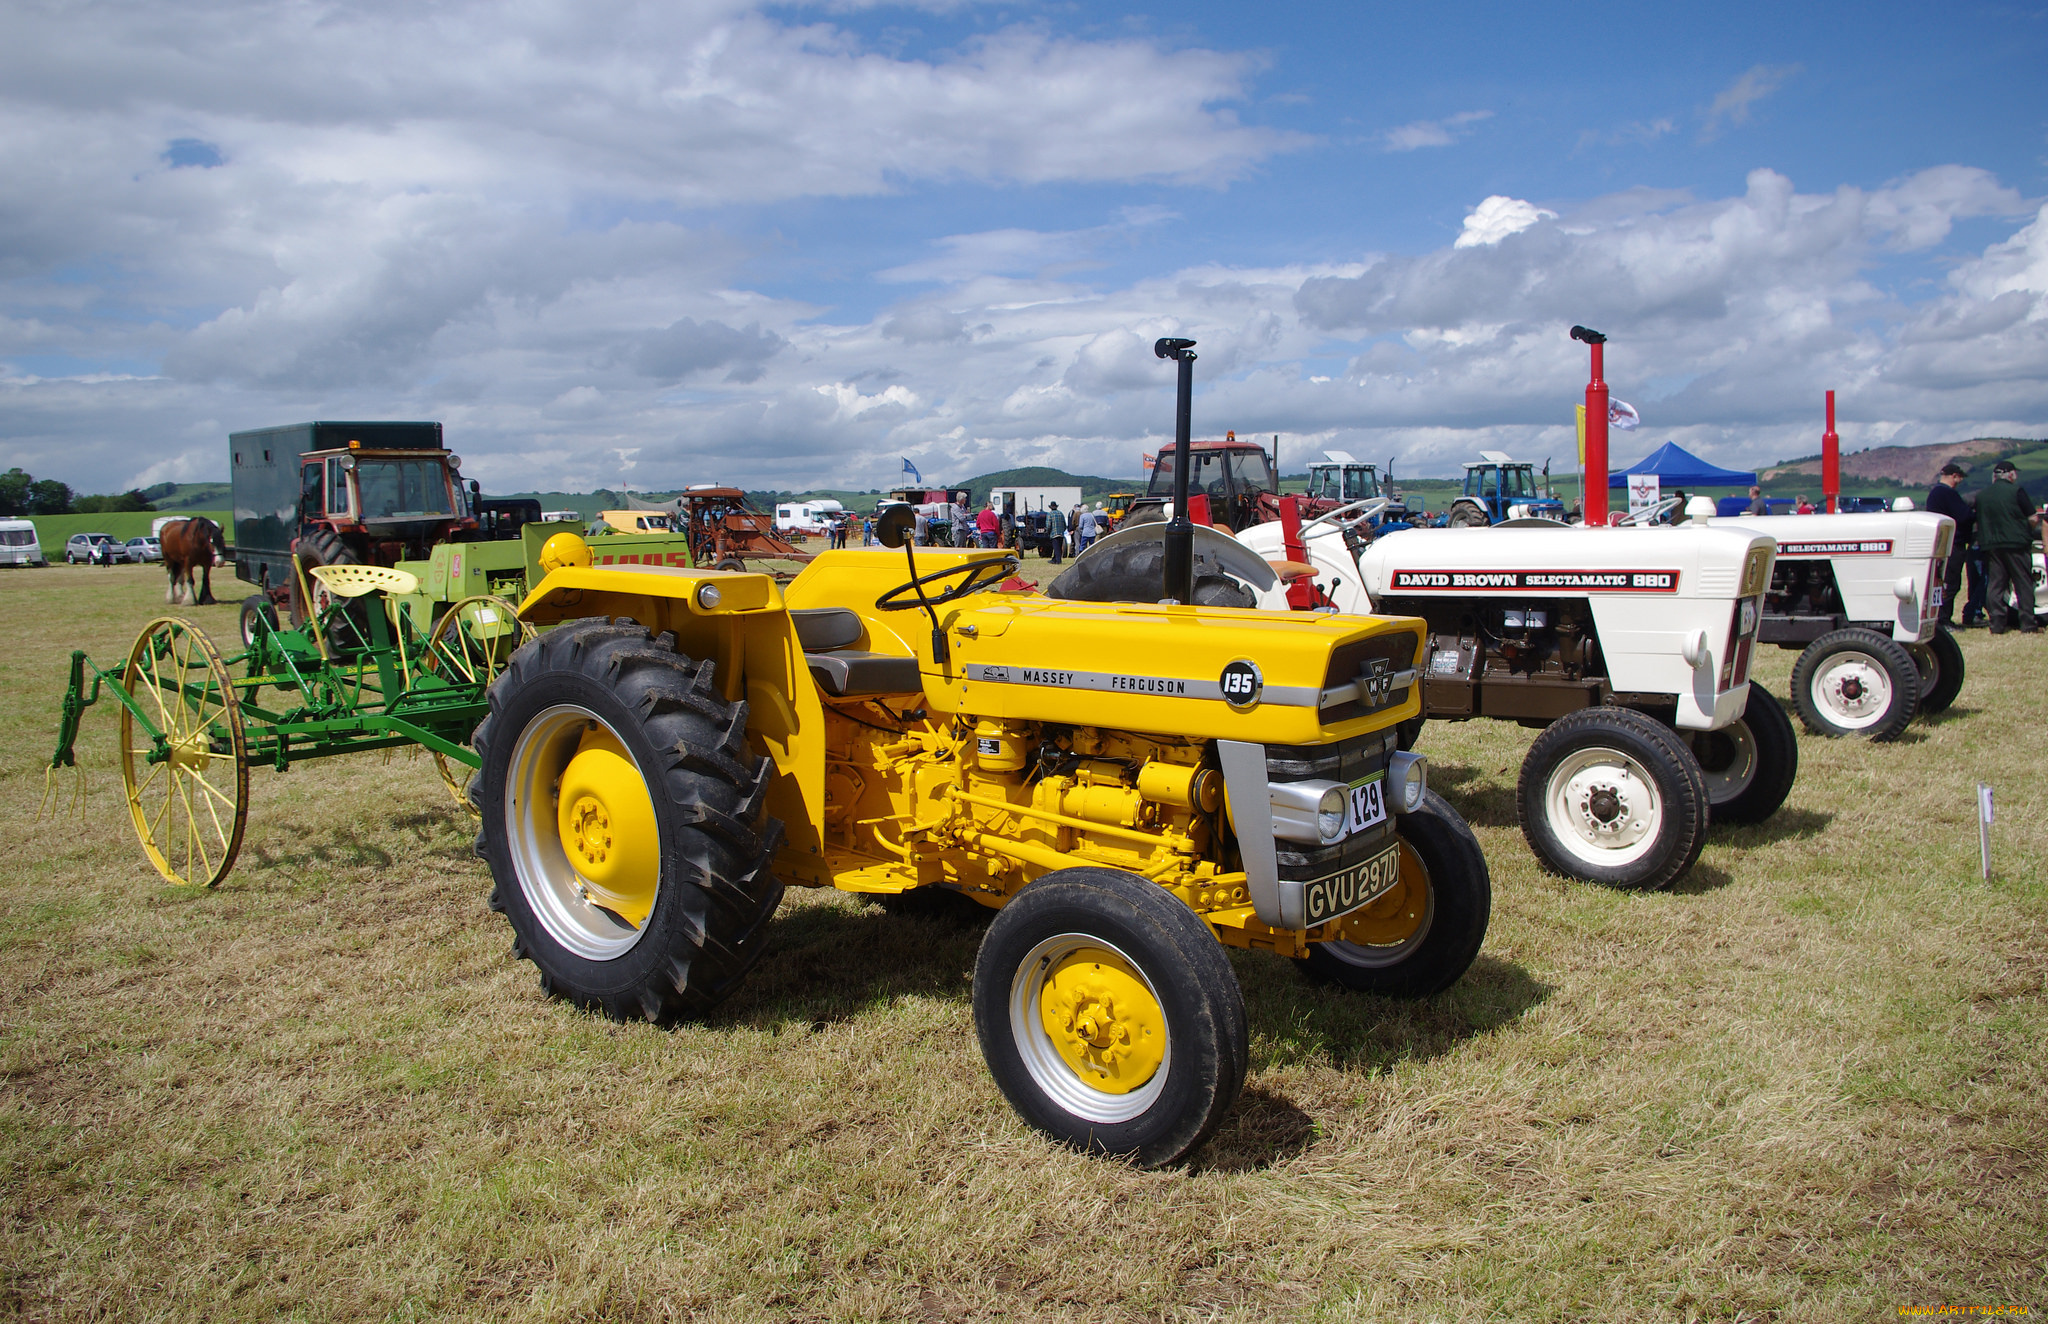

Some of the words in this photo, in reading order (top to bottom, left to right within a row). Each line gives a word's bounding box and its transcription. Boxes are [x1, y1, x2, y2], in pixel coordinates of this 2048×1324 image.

[1787, 543, 1858, 553] SELECTAMATIC
[1860, 542, 1887, 552] 880
[1399, 573, 1449, 585] DAVID
[1453, 574, 1517, 586] BROWN
[1526, 575, 1627, 586] SELECTAMATIC
[1633, 574, 1671, 587] 880
[1023, 670, 1073, 684] MASSEY
[1112, 676, 1185, 693] FERGUSON
[1224, 672, 1253, 693] 135
[1352, 783, 1380, 825] 129
[1309, 872, 1355, 918] GVU
[1358, 850, 1397, 901] 297D
